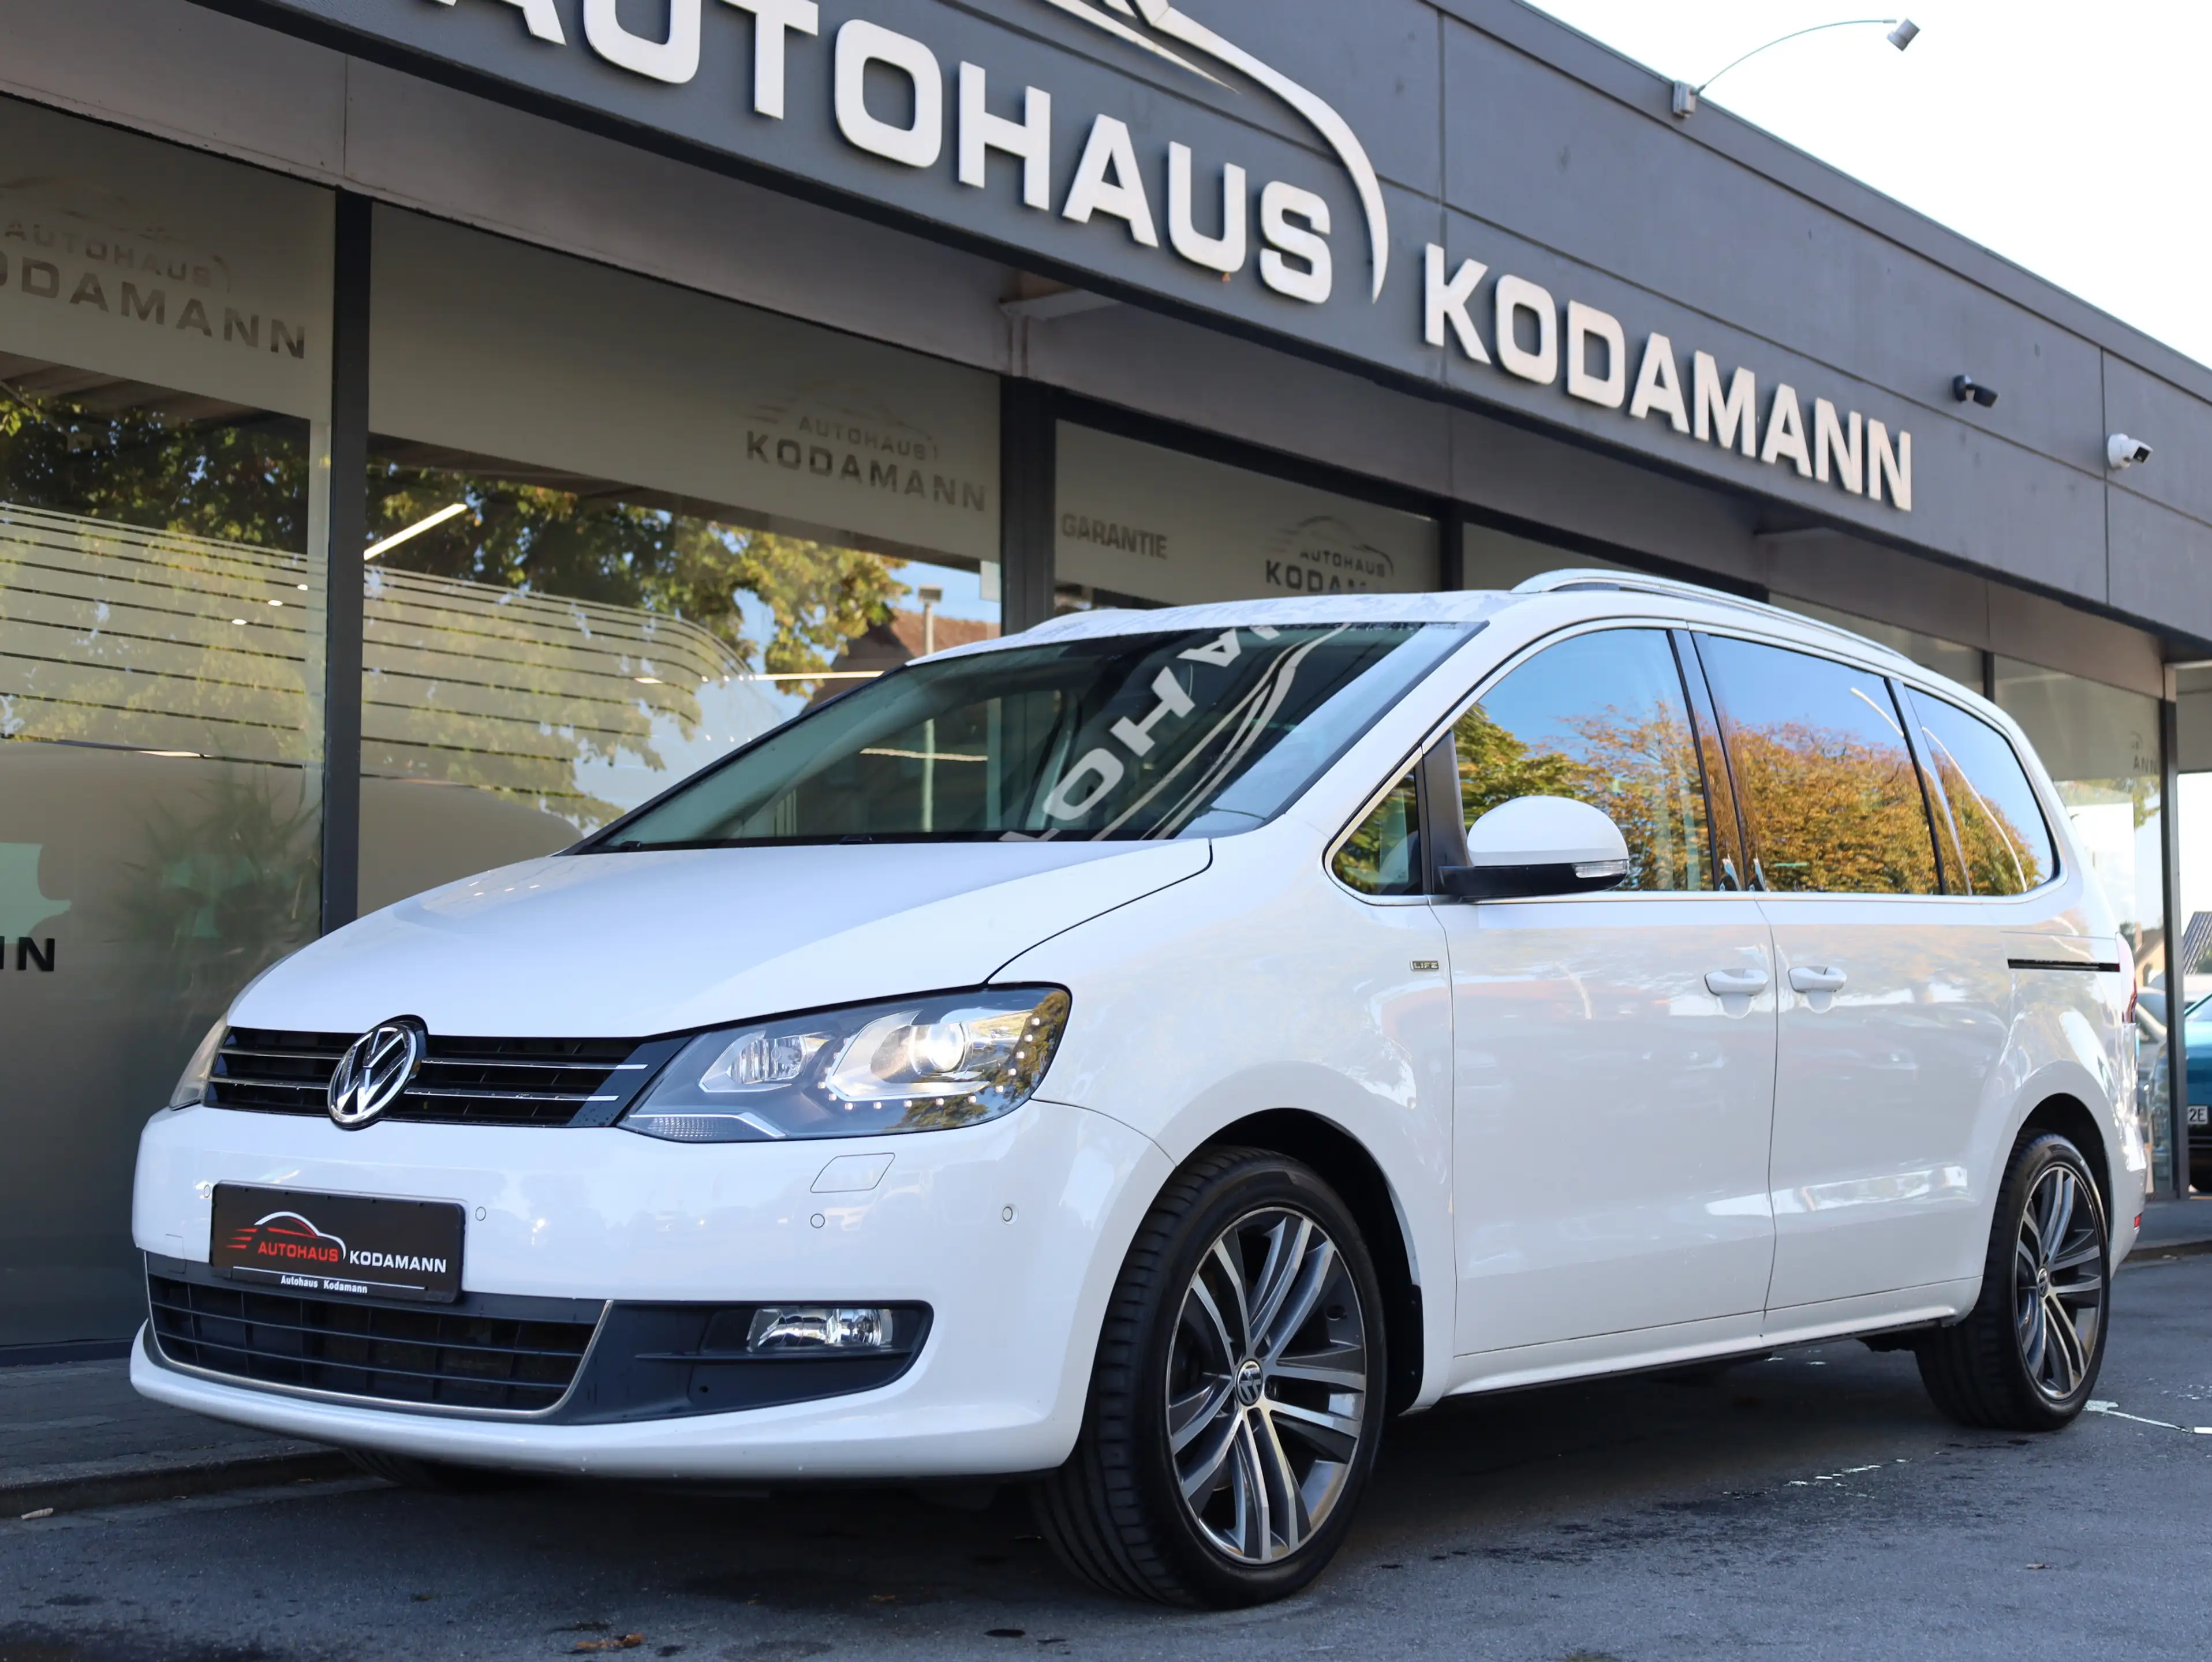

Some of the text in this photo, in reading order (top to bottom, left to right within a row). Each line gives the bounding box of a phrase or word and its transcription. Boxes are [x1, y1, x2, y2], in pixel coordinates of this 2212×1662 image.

[4, 217, 213, 288] AUTOHAUS
[0, 250, 305, 360] DAMANN
[1425, 242, 1912, 512] KODAMANN
[798, 415, 927, 461] AUTOHAUS
[746, 429, 987, 512] KODAMANN
[1062, 512, 1168, 560] GARANTIE
[1299, 548, 1385, 578] AUTOHAUS
[257, 1240, 447, 1273] AUTOHAUS KODAMANN
[281, 1274, 368, 1294] Autohaus Kodamann
